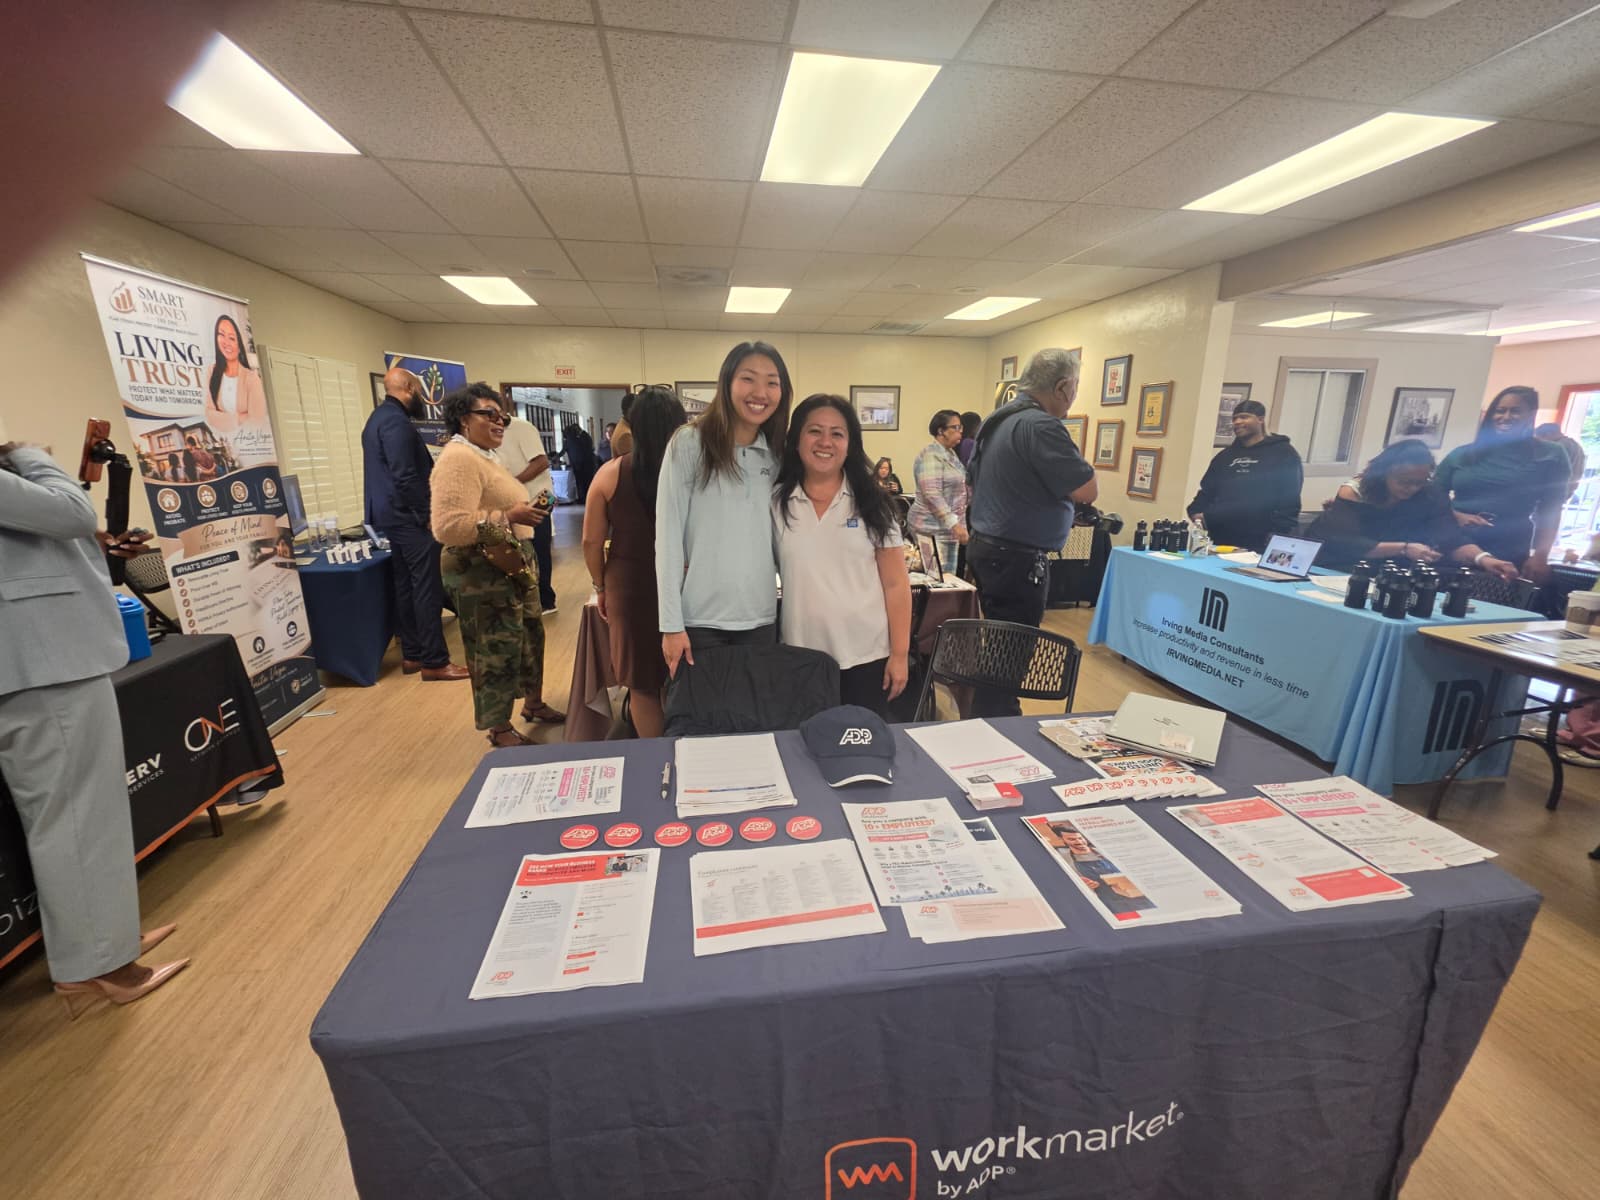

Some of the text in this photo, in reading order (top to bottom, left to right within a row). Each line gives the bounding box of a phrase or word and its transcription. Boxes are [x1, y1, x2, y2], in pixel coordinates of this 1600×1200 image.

[137, 286, 184, 308] SMART
[142, 302, 188, 322] MONEY
[114, 331, 203, 366] LIVING
[120, 358, 203, 388] TRUST
[128, 384, 158, 393] PROTECT
[176, 389, 202, 397] MATTERS
[130, 394, 152, 402] TODAY
[201, 517, 262, 542] Peace of Mind
[176, 554, 231, 574] WHAT'S INCLUDED?
[1162, 616, 1264, 665] Irving Media Consultants
[1159, 630, 1200, 653] productivity
[1200, 647, 1216, 658] and
[1216, 654, 1252, 674] revenue
[1252, 668, 1262, 678] in
[1264, 671, 1284, 688] less
[1286, 682, 1310, 698] time
[1166, 648, 1245, 688] IRVINGMEDIA.NET
[184, 698, 240, 751] ONE
[839, 728, 872, 746] ADP
[563, 829, 596, 838] ADP
[607, 827, 639, 837] ADP
[658, 826, 688, 838] ADP
[702, 824, 728, 839] ADP
[744, 821, 772, 832] ADP
[791, 818, 816, 832] ADP
[936, 1180, 962, 1198] by
